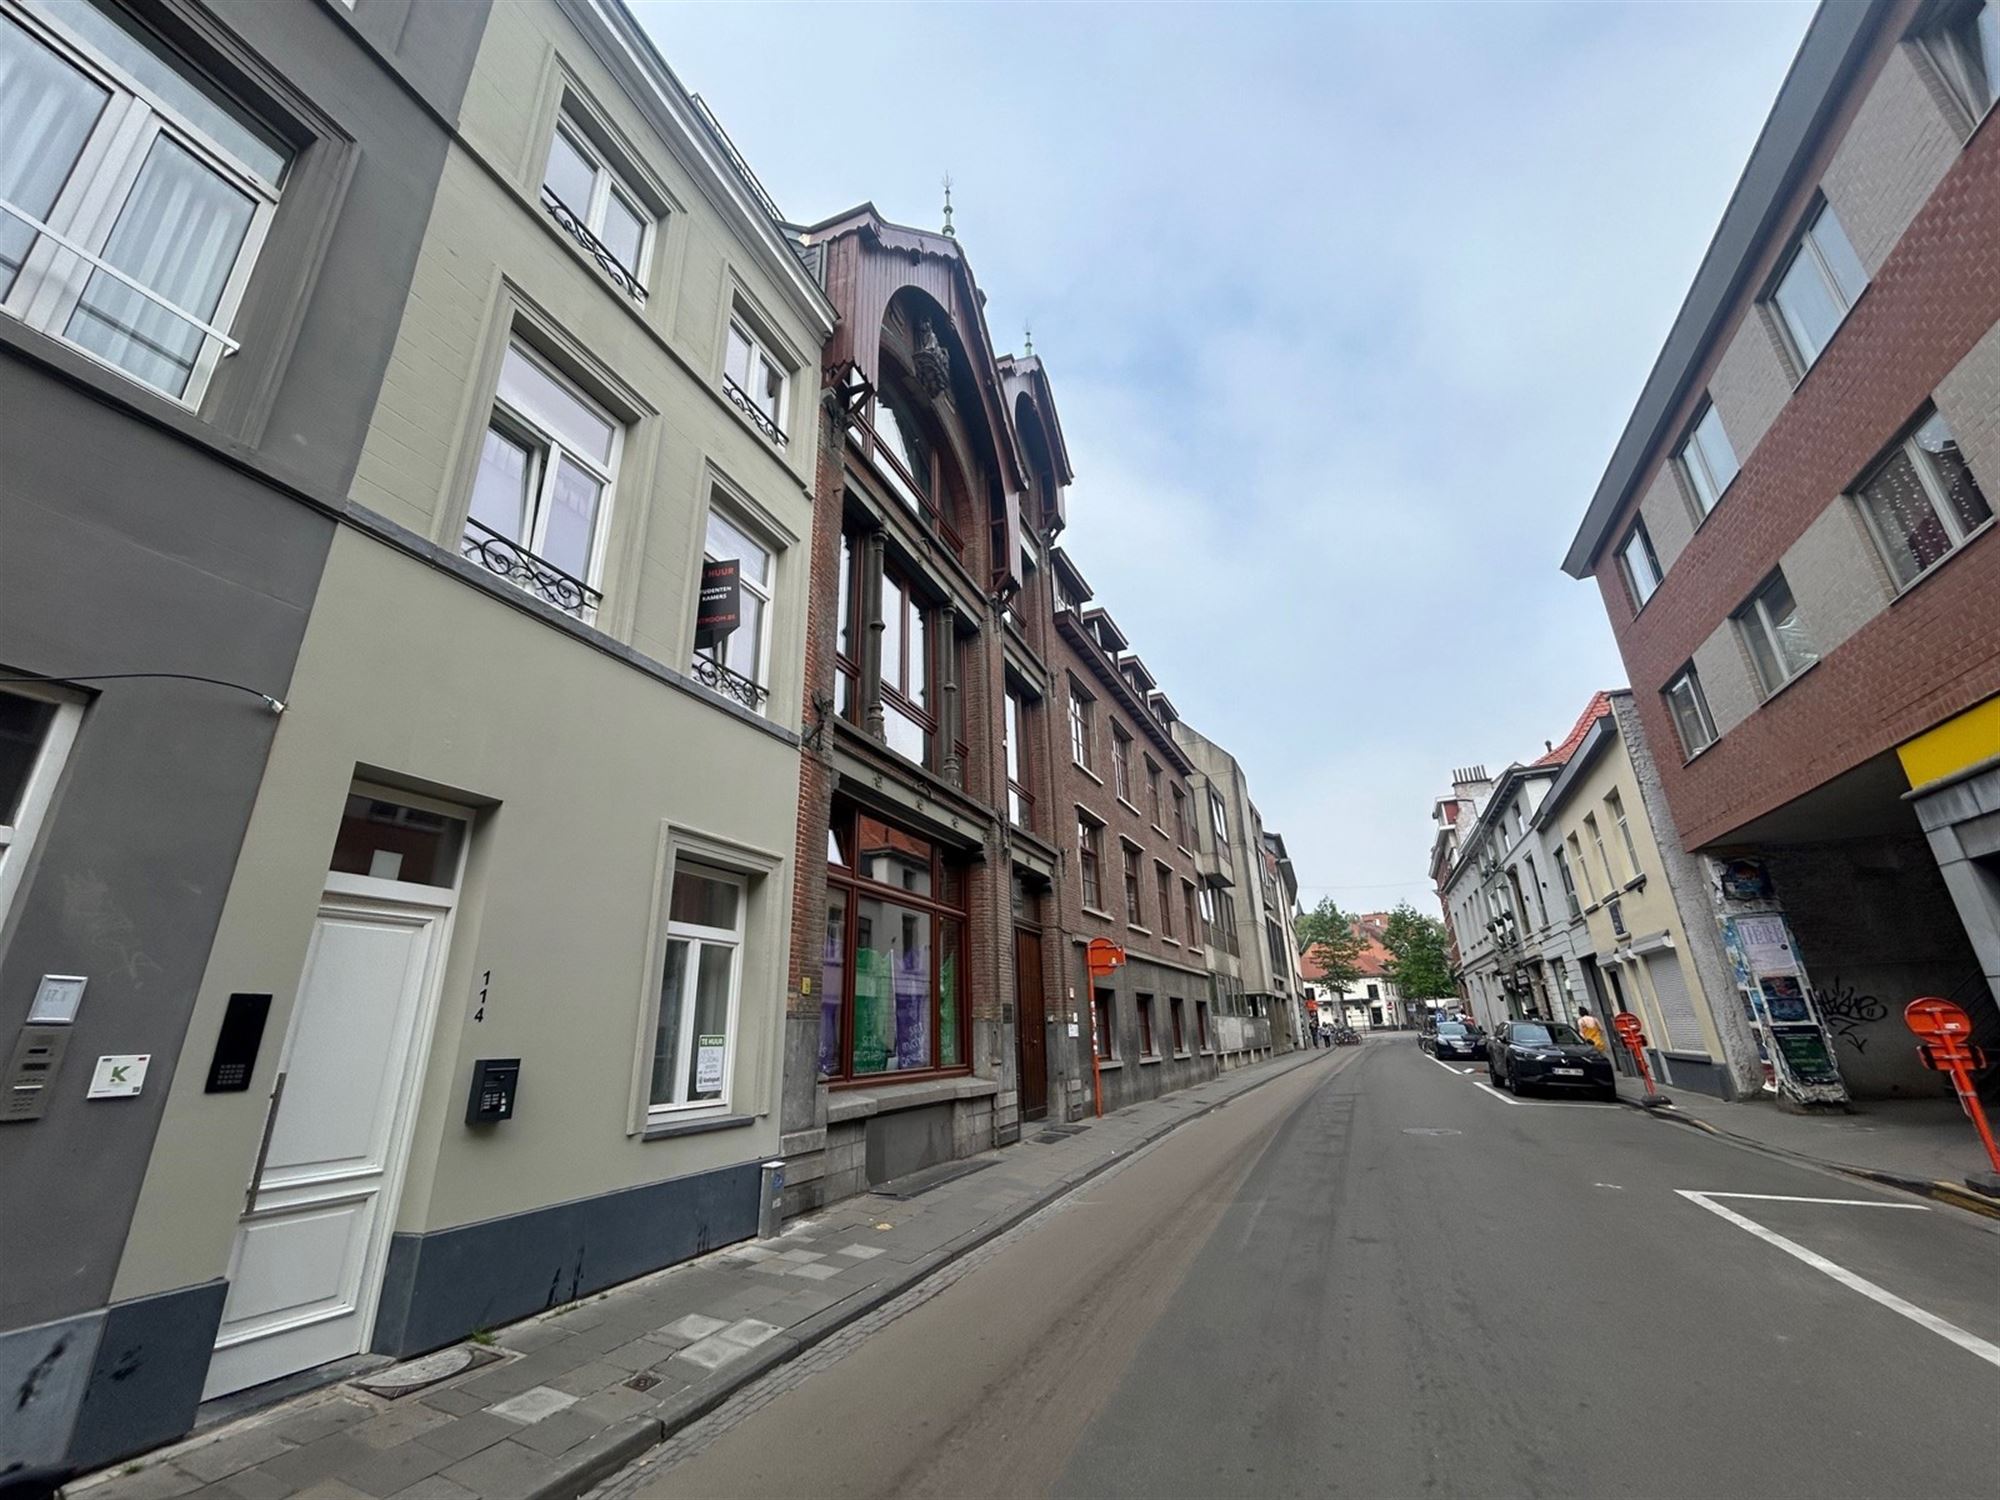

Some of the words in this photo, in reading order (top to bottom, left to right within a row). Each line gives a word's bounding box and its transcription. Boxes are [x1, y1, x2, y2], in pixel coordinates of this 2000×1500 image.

[708, 567, 735, 577] HUUR
[702, 593, 728, 602] KAMERS
[709, 1038, 723, 1046] HUUR
[110, 1065, 132, 1082] K
